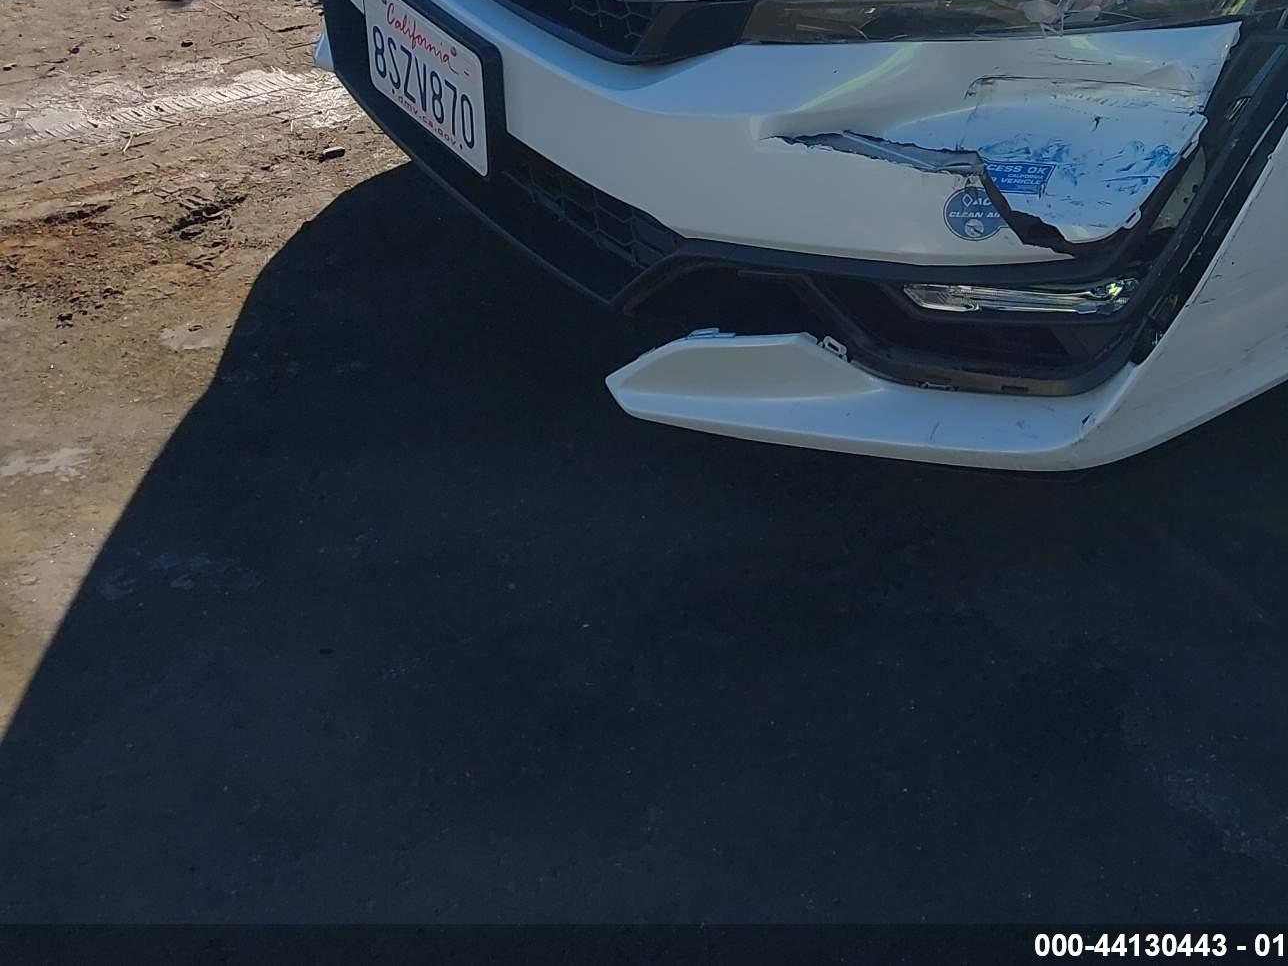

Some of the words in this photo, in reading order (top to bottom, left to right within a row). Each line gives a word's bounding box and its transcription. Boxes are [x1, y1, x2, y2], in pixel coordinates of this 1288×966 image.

[386, 2, 458, 74] California
[372, 25, 475, 150] 8SZV870
[1027, 166, 1049, 174] OK
